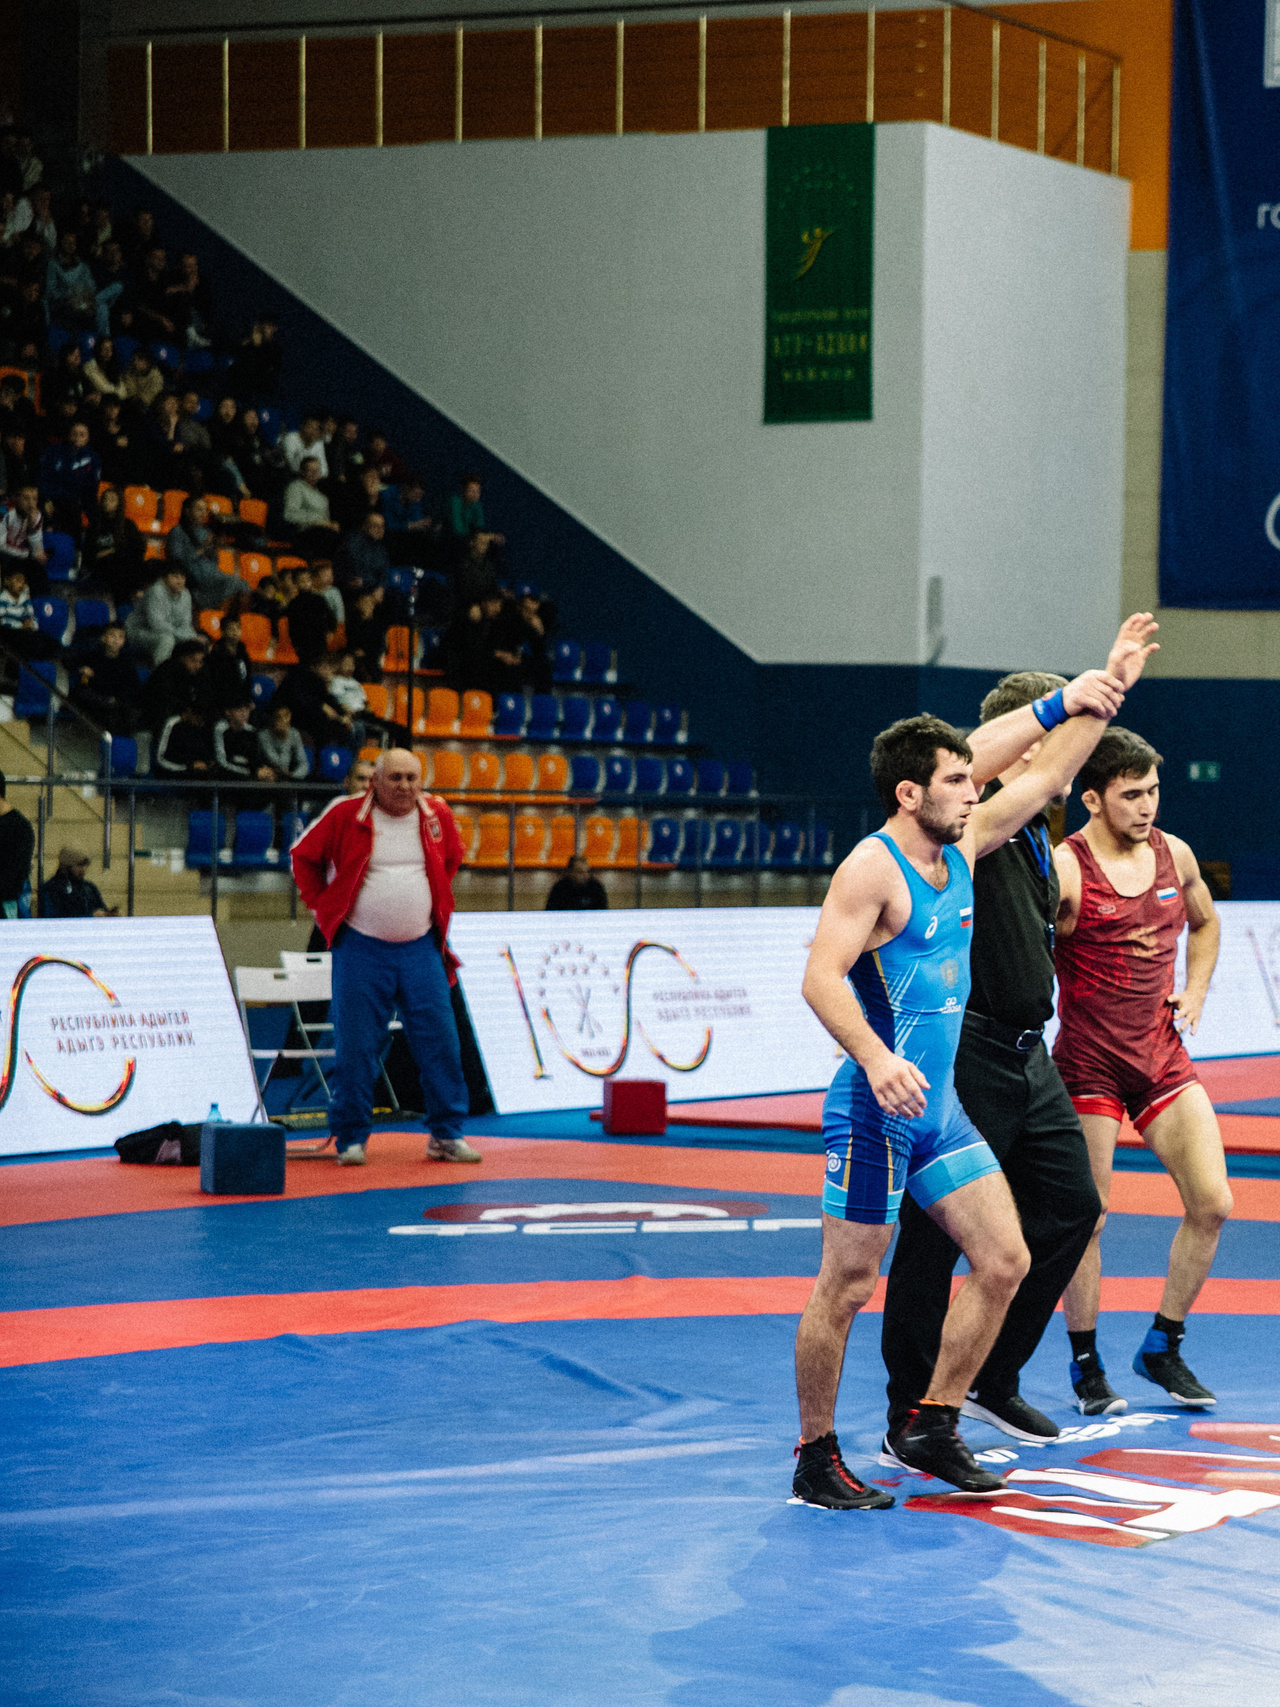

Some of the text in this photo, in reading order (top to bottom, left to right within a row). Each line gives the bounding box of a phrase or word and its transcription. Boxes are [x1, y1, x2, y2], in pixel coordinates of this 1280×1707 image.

[51, 1009, 190, 1031] РЕСПУБЛИКА АДЫГЕЯ
[111, 1029, 195, 1051] РЕСПУБЛИК
